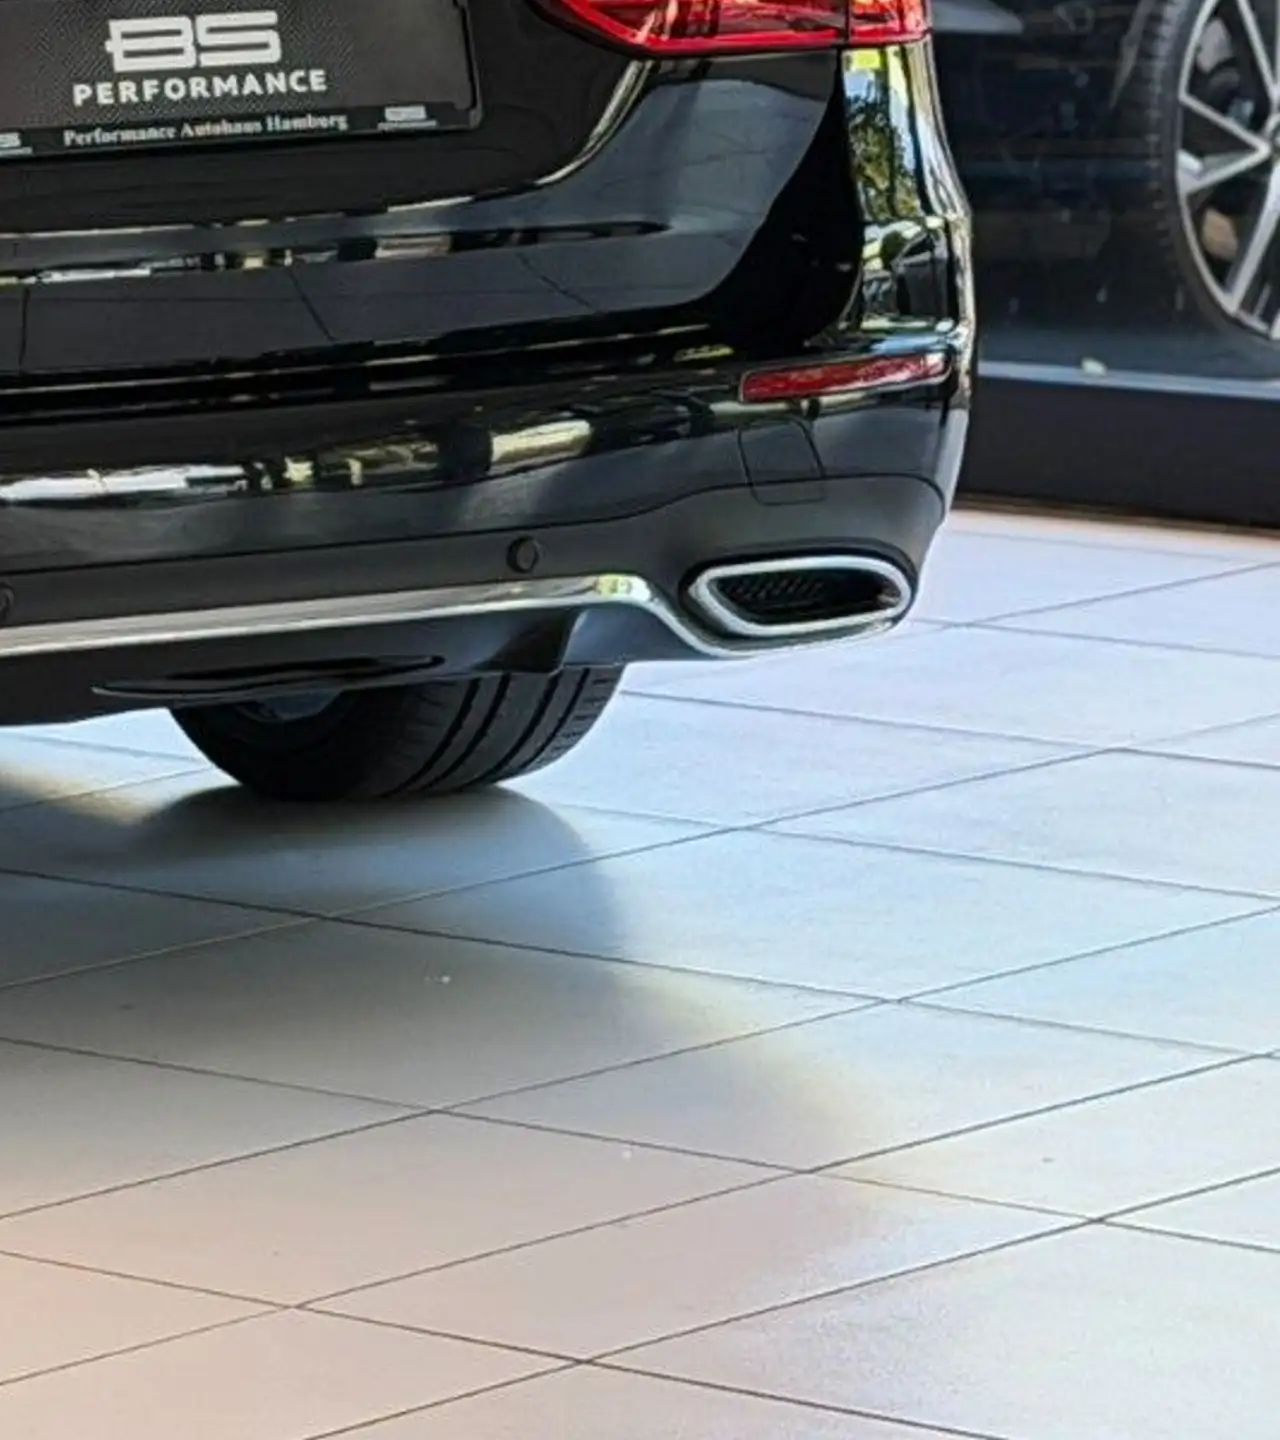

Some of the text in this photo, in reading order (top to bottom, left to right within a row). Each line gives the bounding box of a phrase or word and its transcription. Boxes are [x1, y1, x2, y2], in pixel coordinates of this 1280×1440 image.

[72, 69, 328, 107] PERFORMANCE
[62, 126, 178, 147] Performance
[179, 118, 263, 139] Autohaus
